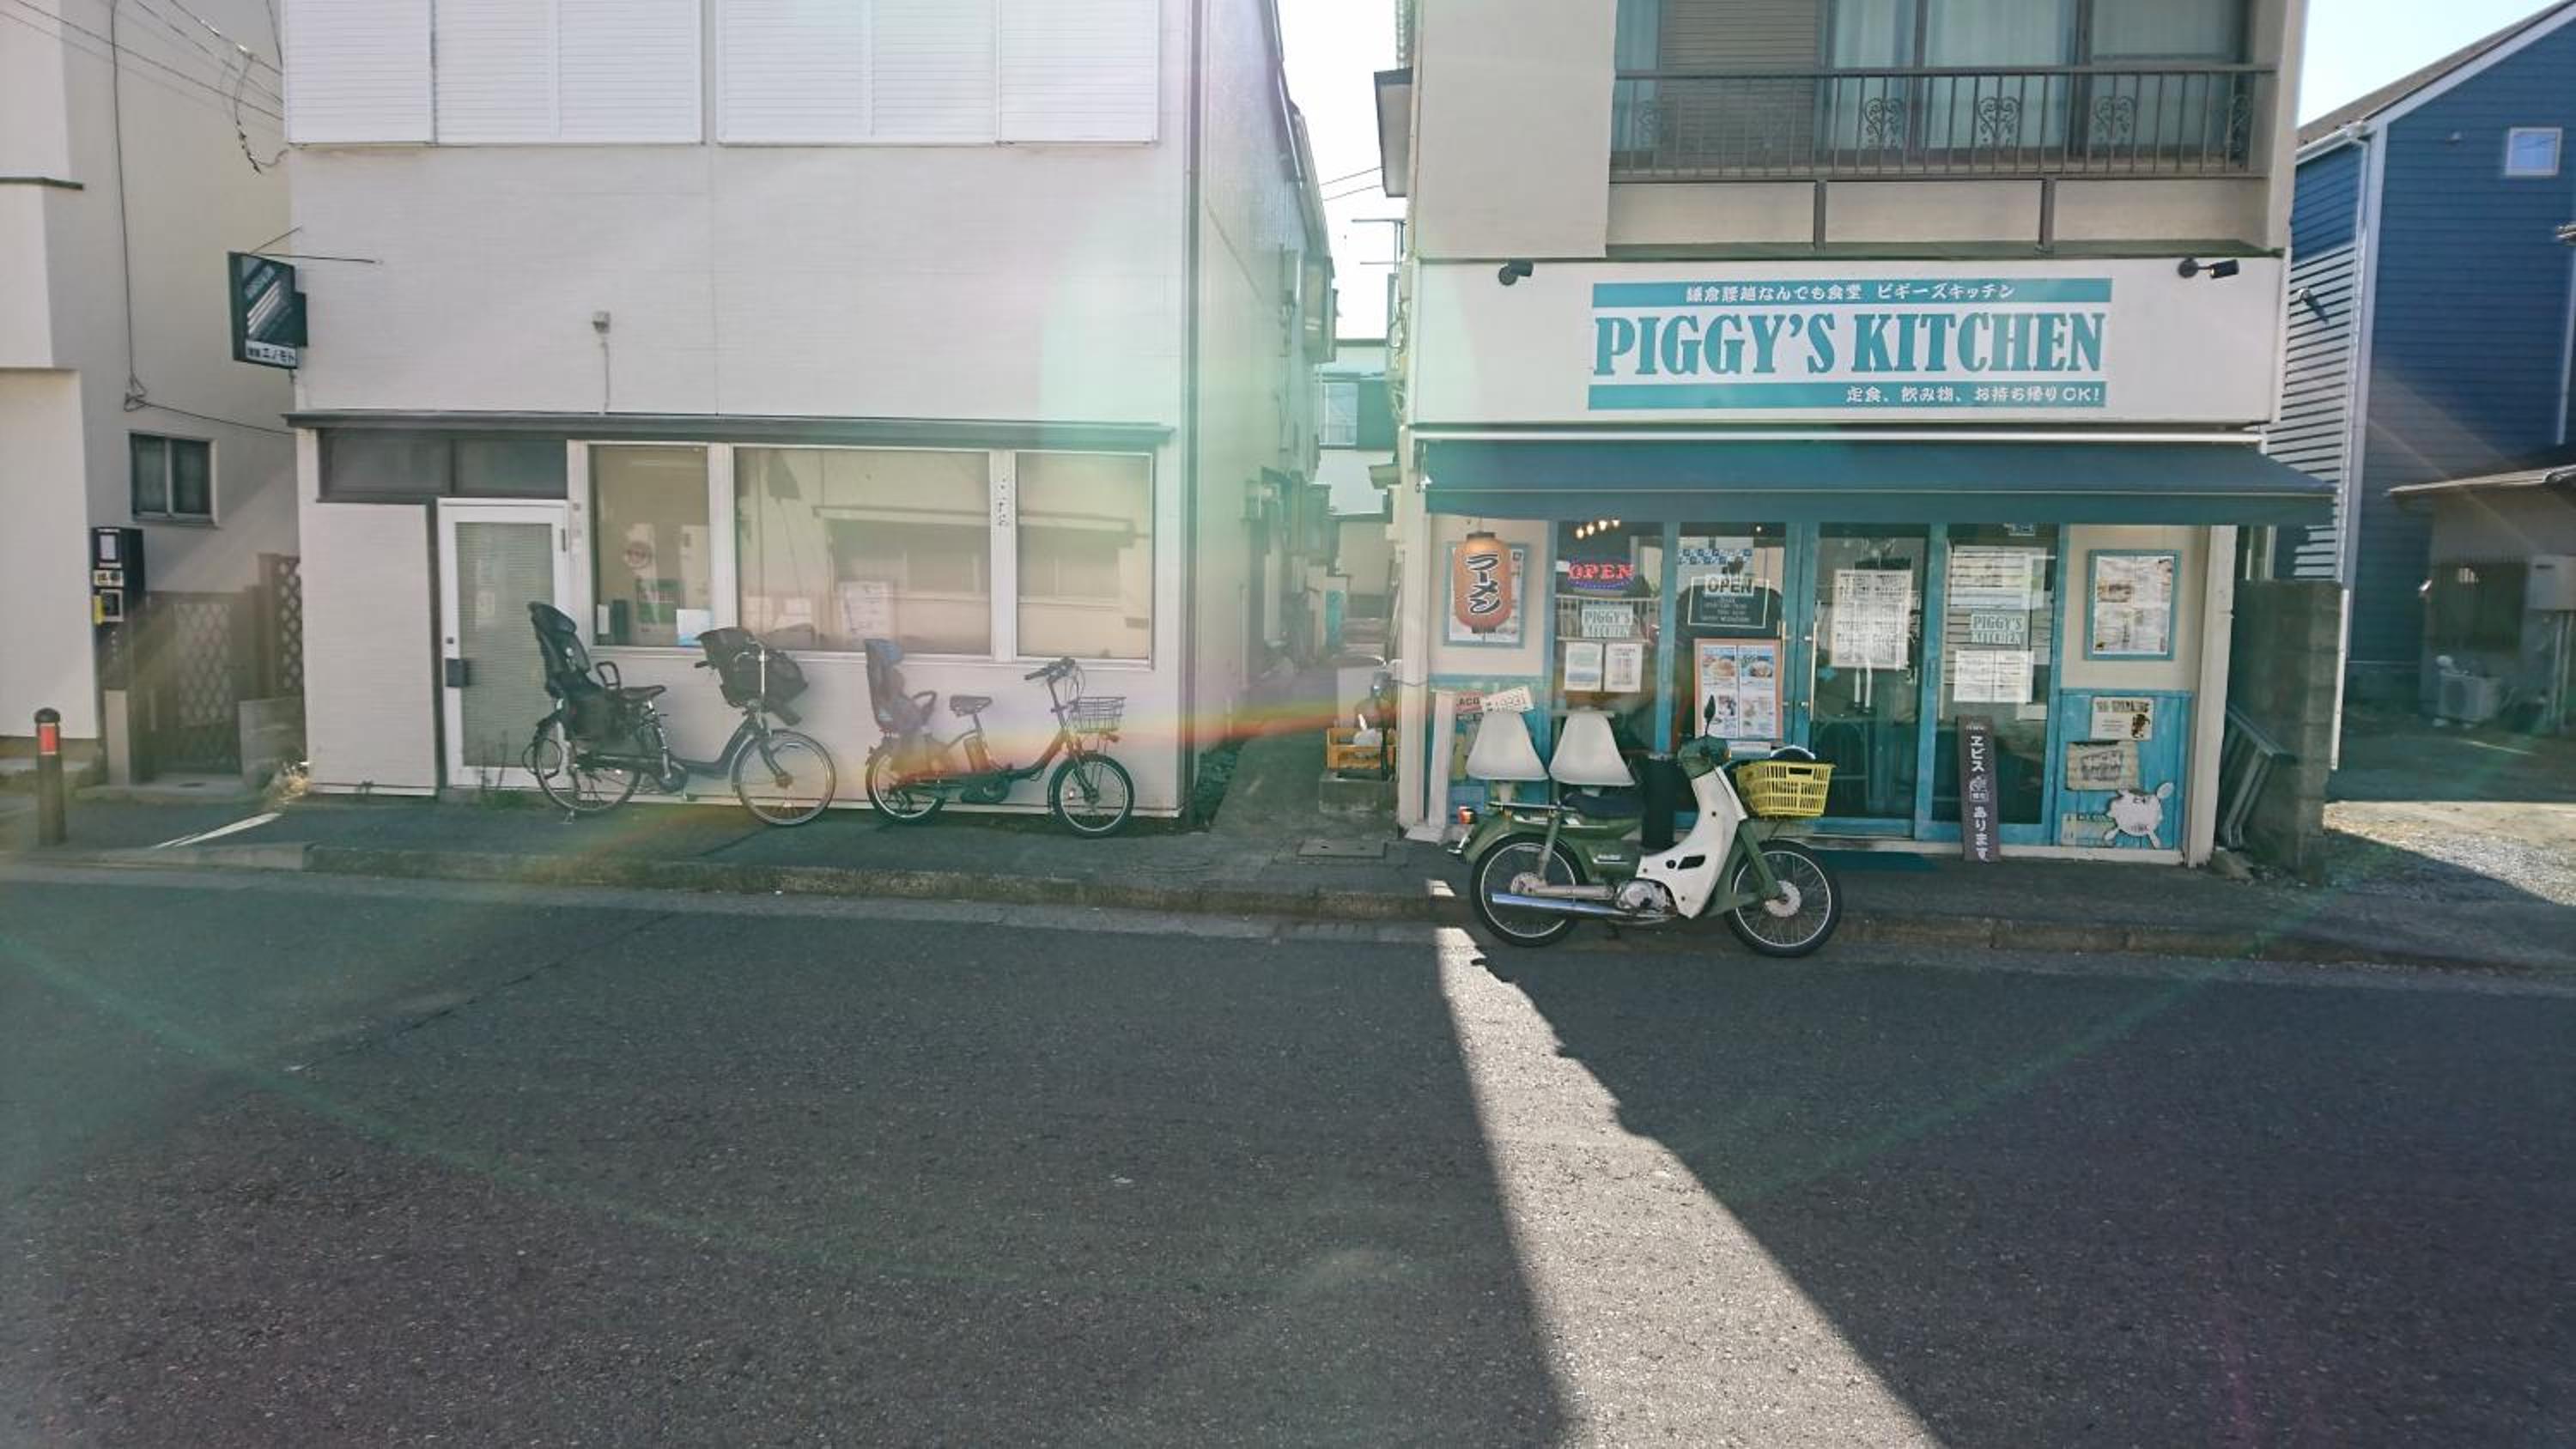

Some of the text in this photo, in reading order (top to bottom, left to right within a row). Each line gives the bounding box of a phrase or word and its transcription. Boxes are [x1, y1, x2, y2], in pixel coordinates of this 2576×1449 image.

[1595, 312, 2106, 376] PIGGY'S KITCHEN
[1569, 563, 1635, 579] OPEN
[1467, 554, 1501, 614] ラーメン
[1708, 577, 1752, 593] OPEN
[1584, 610, 1630, 623] PIGGY'S
[1973, 616, 2022, 630] PIGGY'S
[1971, 631, 2020, 644] KITCHEN
[1973, 806, 1990, 862] あります
